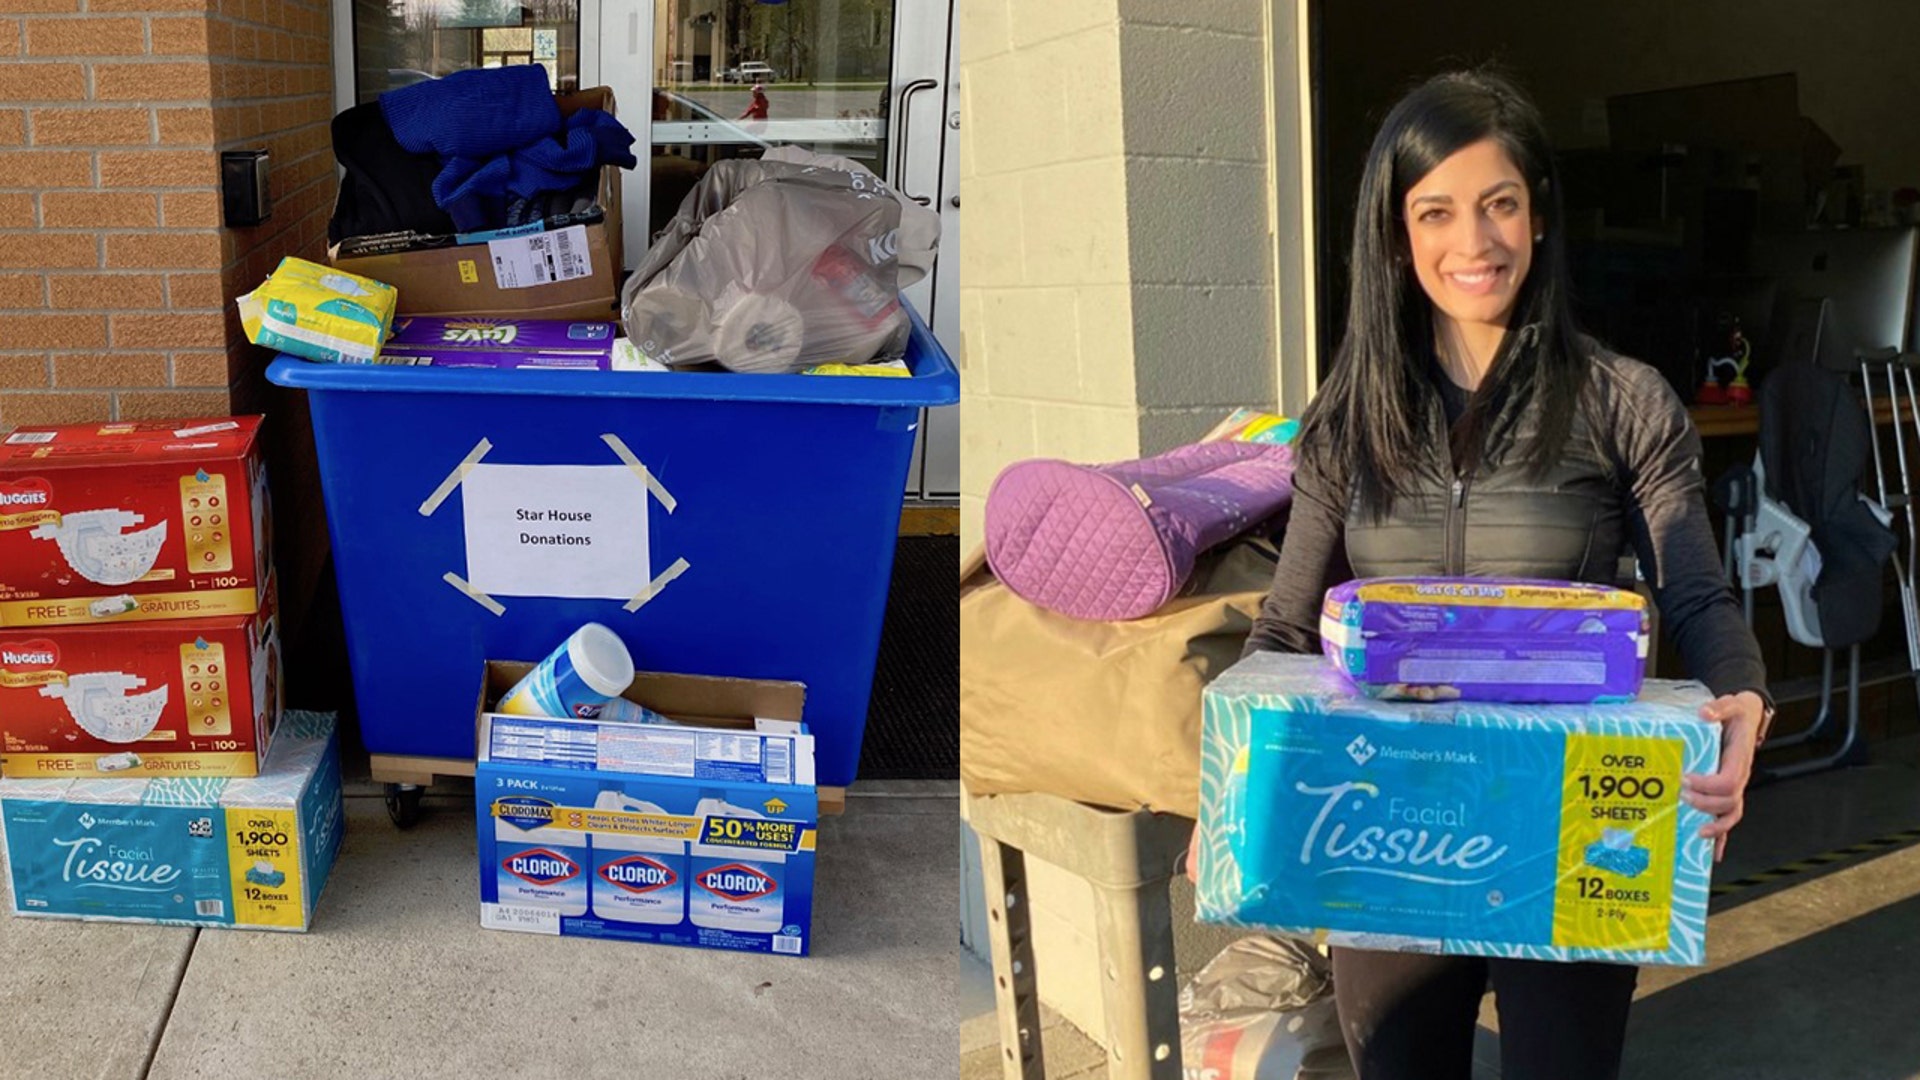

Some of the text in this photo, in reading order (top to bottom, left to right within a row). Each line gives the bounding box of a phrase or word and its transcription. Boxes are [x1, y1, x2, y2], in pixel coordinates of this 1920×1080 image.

[443, 324, 518, 343] Luvs
[516, 508, 592, 521] Star House
[520, 533, 592, 545] Donations
[215, 576, 238, 588] 100
[27, 603, 68, 619] FREE
[140, 599, 200, 613] GRATUITES
[2, 651, 54, 664] HUGGIES
[215, 740, 238, 750] 100
[1380, 746, 1478, 764] Member's Mark
[1601, 755, 1645, 768] OVER
[37, 760, 75, 771] FREE
[144, 759, 201, 771] GRATUITES
[496, 778, 504, 788] 3
[507, 779, 539, 790] PACK
[1578, 775, 1665, 800] 1,900
[767, 804, 786, 814] UP
[1389, 797, 1466, 827] Facial
[1591, 806, 1647, 821] SHEETS
[98, 817, 135, 827] Member's
[248, 820, 274, 829] OVER
[610, 816, 641, 825] Clothes
[670, 820, 696, 830] Longer
[756, 821, 796, 833] MORE
[1296, 781, 1509, 869] Tissue
[619, 825, 650, 835] Protects
[756, 831, 794, 842] USES!
[236, 831, 288, 846] 1,900
[53, 837, 182, 882] Tissue
[108, 845, 154, 861] Facial
[246, 849, 280, 858] SHEETS
[512, 858, 570, 876] CLOROX
[608, 865, 667, 885] CLOROX
[706, 872, 766, 892] CLOROX
[244, 888, 289, 901] 12 BOXES
[519, 887, 566, 897] Performance
[1576, 877, 1650, 902] 12 BOXES
[613, 895, 662, 905] Performance
[711, 903, 761, 914] Performance
[1597, 909, 1626, 920] 2-Ply
